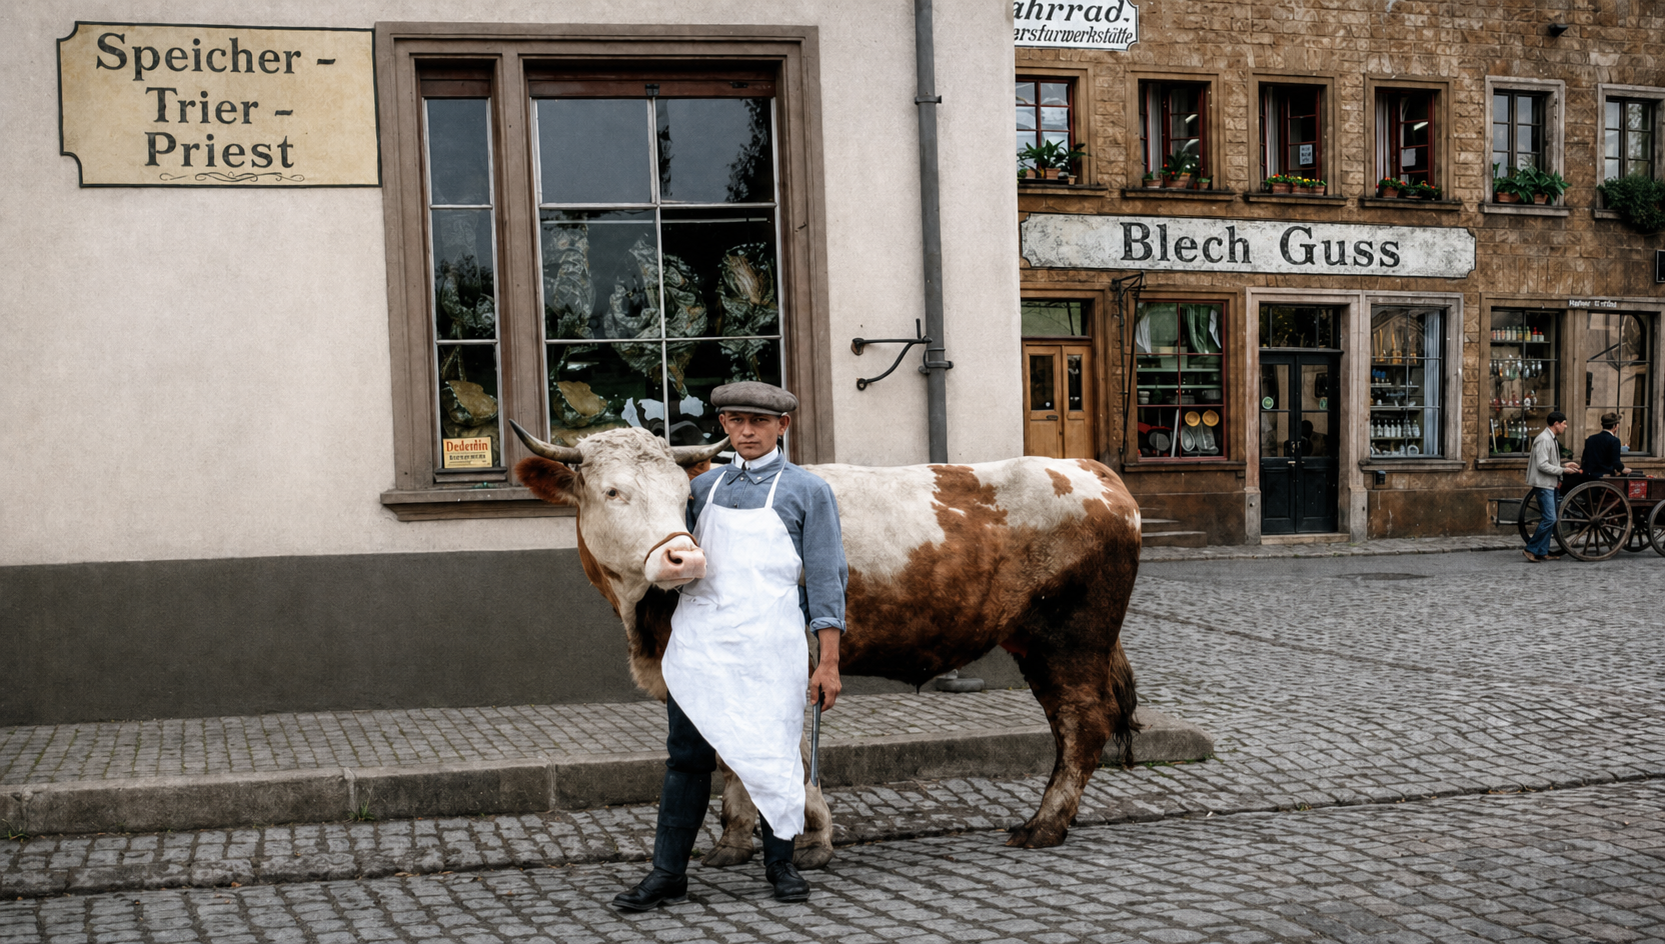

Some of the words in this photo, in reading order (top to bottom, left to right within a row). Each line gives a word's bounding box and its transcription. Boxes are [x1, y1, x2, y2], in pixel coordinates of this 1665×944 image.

[96, 32, 302, 81] Speicher
[145, 86, 259, 125] Trier
[144, 131, 295, 169] Priest
[1119, 221, 1252, 264] Blech
[1279, 225, 1401, 268] Guss
